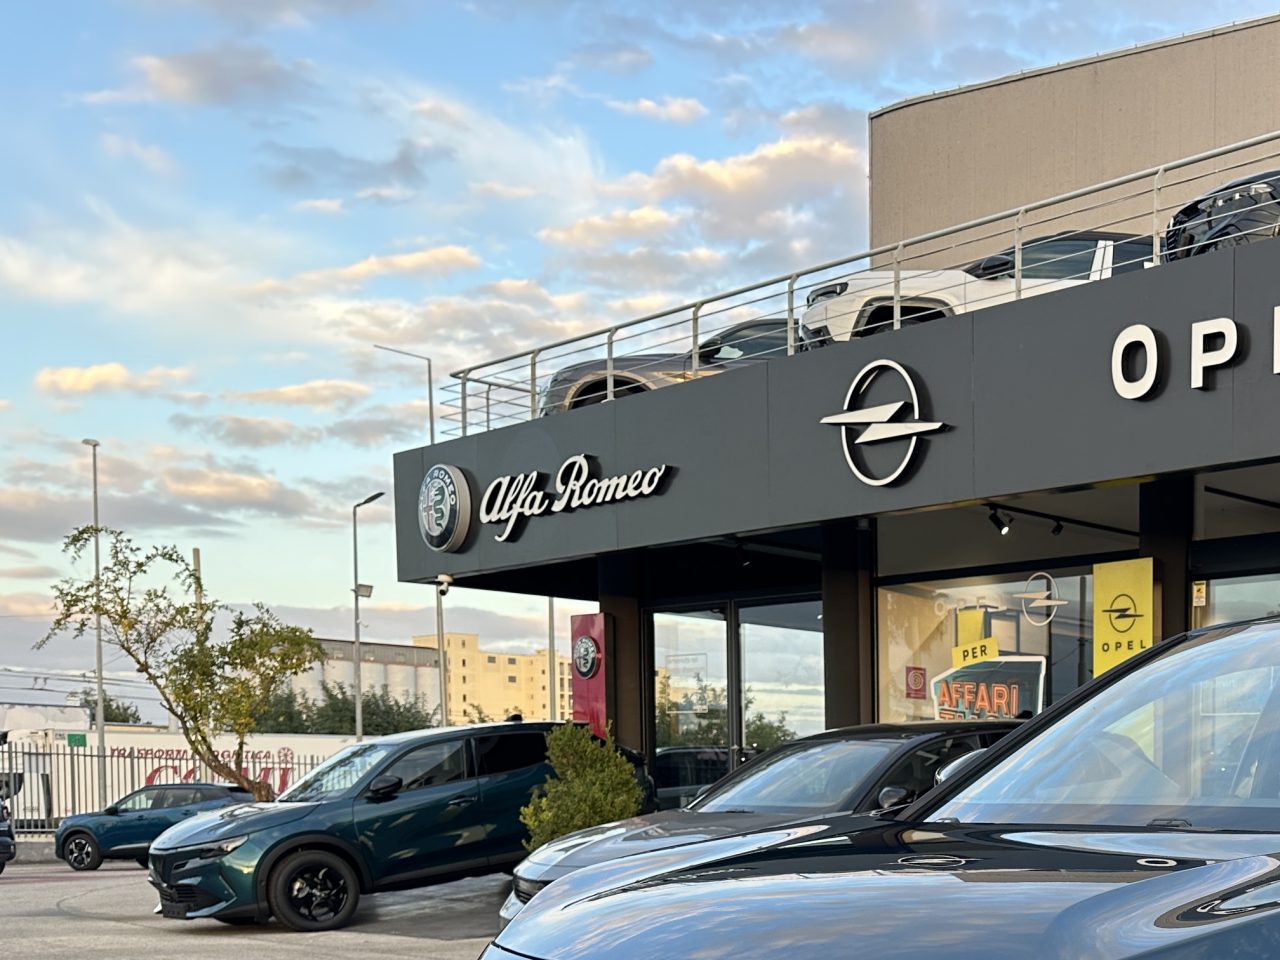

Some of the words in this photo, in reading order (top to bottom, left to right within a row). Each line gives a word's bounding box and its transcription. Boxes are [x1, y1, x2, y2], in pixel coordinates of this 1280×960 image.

[479, 470, 550, 542] Alfa
[551, 453, 666, 512] Romeo
[962, 644, 988, 662] PER
[1101, 639, 1147, 652] OPEL
[938, 680, 1020, 718] AFFARI
